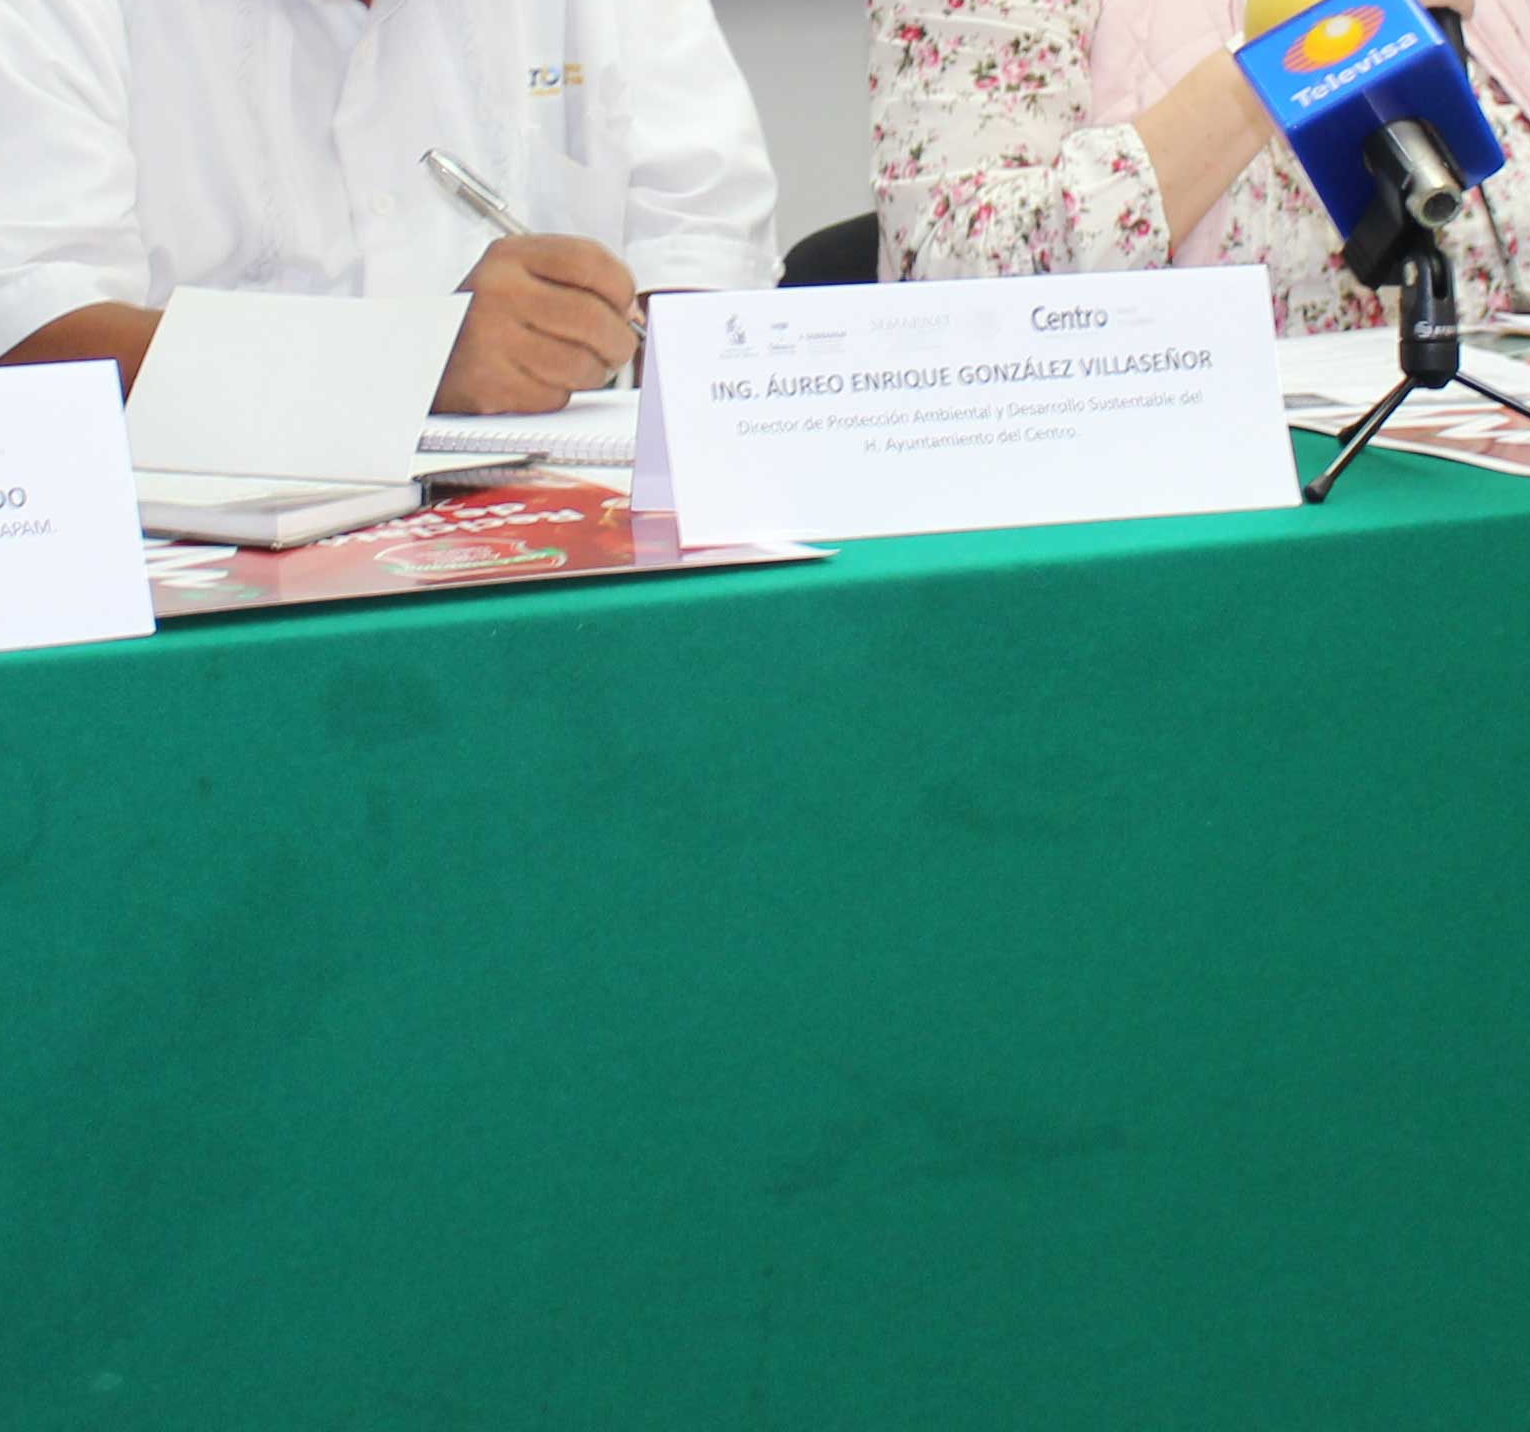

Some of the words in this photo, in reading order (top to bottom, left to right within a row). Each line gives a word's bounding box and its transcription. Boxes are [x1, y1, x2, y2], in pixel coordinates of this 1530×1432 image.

[1290, 32, 1420, 109] Televisa
[1031, 305, 1109, 332] Centro
[710, 379, 760, 402] ING.
[766, 371, 845, 399] ÁUREO
[852, 365, 953, 394] ENRIQUE
[958, 355, 1074, 386] GONZÁLEZ
[1079, 346, 1215, 376] VILLASEÑOR
[736, 417, 799, 437] Director
[803, 415, 823, 431] de
[913, 404, 993, 425] Ambiental
[1007, 399, 1086, 418] Desarrollo
[1087, 391, 1176, 412] Sustentable
[885, 429, 994, 453] Ayuntamiento
[997, 427, 1021, 444] del
